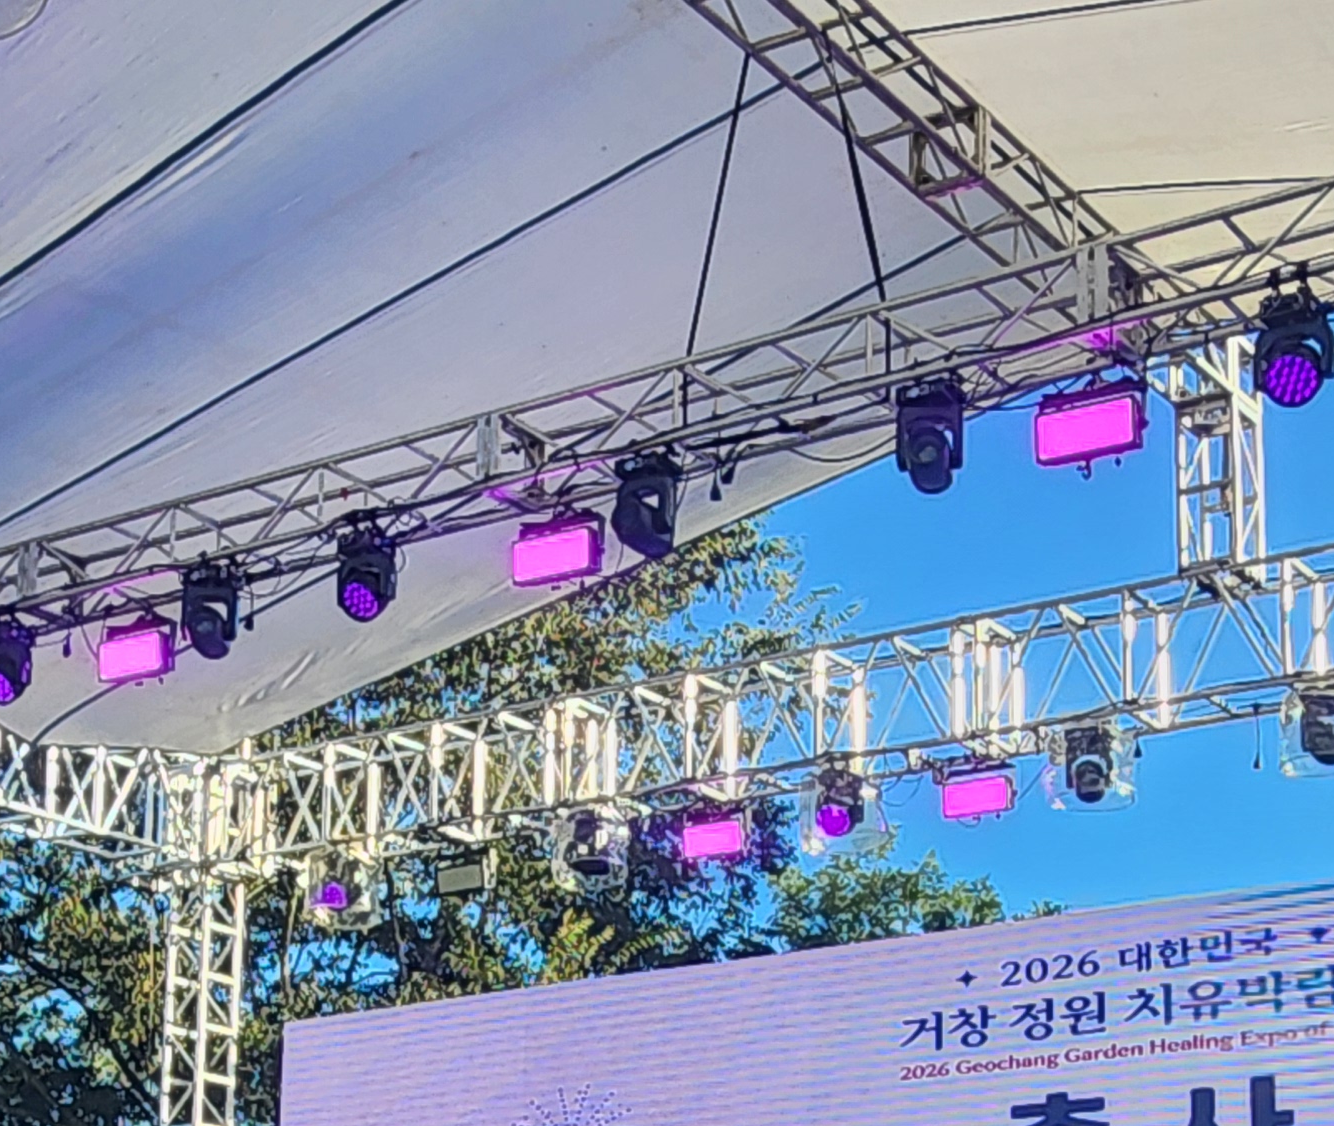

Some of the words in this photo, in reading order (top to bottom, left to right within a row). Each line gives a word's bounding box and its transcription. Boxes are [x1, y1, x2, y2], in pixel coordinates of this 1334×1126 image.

[1000, 950, 1101, 987] 2026
[1118, 928, 1278, 973] 대한민국
[899, 1005, 997, 1051] 거창
[1009, 991, 1107, 1041] 정원
[900, 1061, 950, 1081] 2026
[955, 1053, 1060, 1075] Geochang
[1064, 1043, 1144, 1063] Garden
[1149, 1034, 1234, 1055] Healing
[1240, 1028, 1298, 1047] Expo
[1305, 1020, 1331, 1038] of
